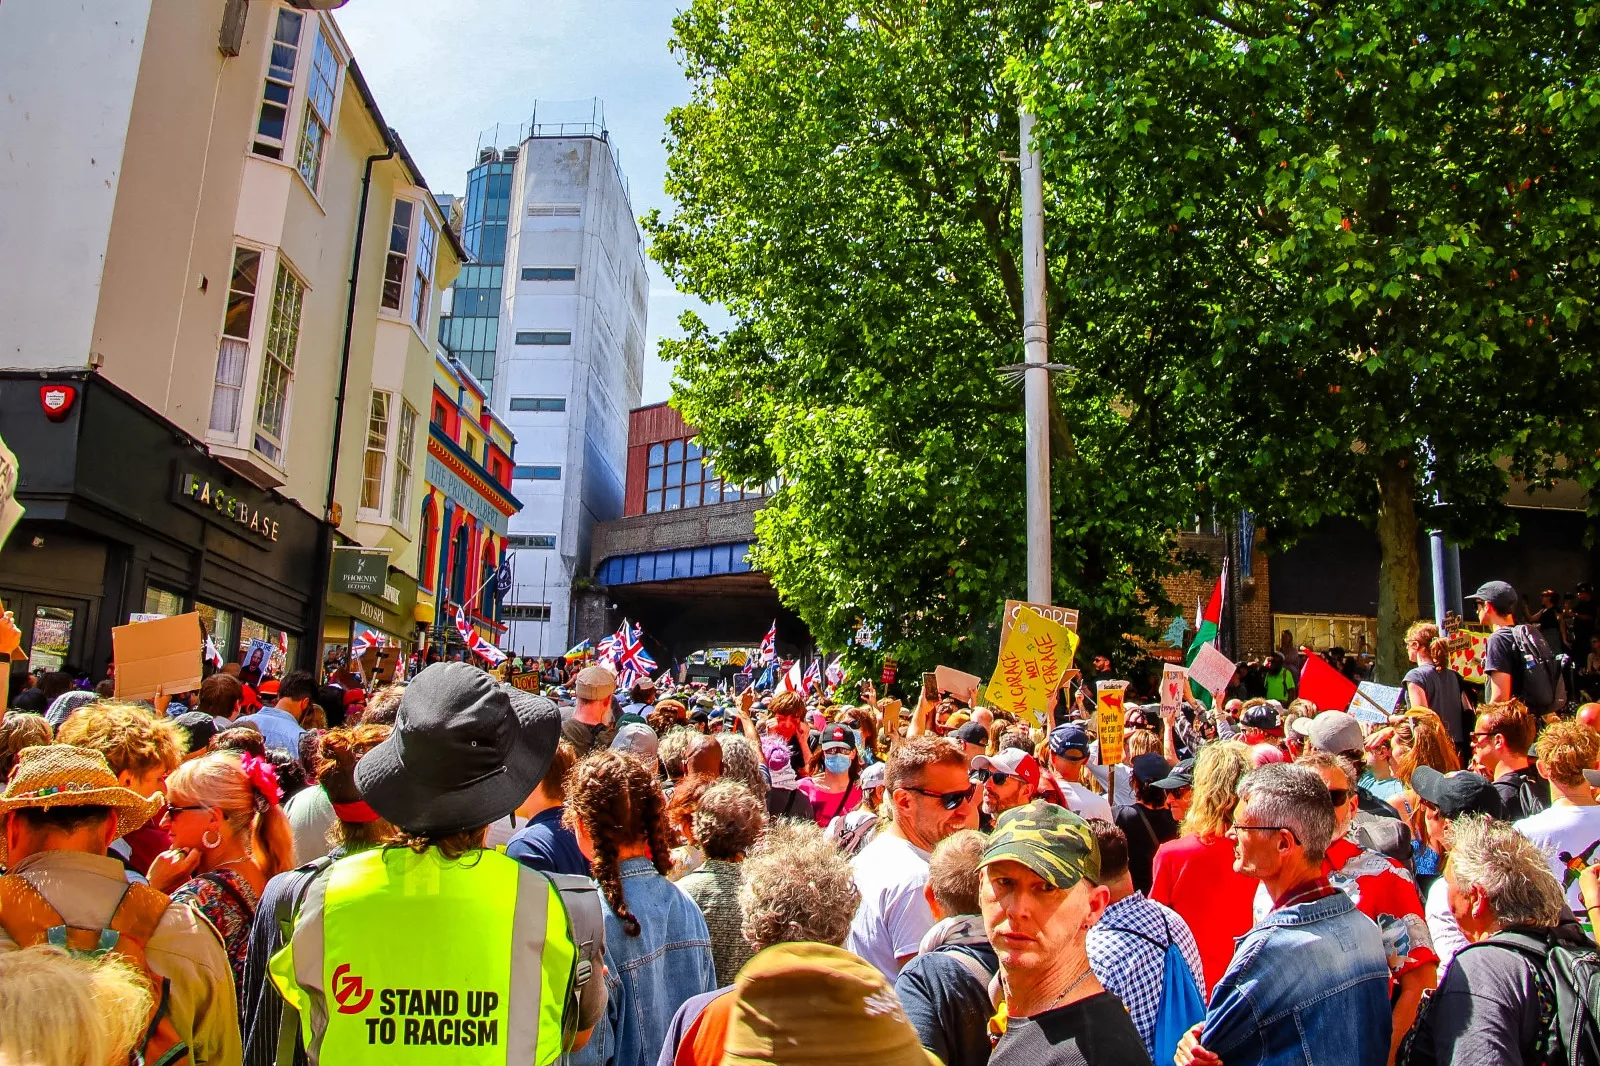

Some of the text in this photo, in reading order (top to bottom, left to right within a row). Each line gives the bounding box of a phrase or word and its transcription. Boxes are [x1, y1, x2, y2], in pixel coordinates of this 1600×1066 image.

[431, 460, 499, 528] THE PRINCE ALBERT
[342, 574, 378, 583] PHOENIX
[360, 601, 384, 624] ECO SPA
[1023, 656, 1039, 680] NOT
[1034, 632, 1059, 685] FARAGE
[513, 675, 538, 690] LOVE
[1000, 651, 1029, 714] UK GARAGE
[1101, 712, 1118, 725] Togethe
[379, 988, 499, 1018] STAND UP
[365, 1017, 499, 1046] TO RACISM
